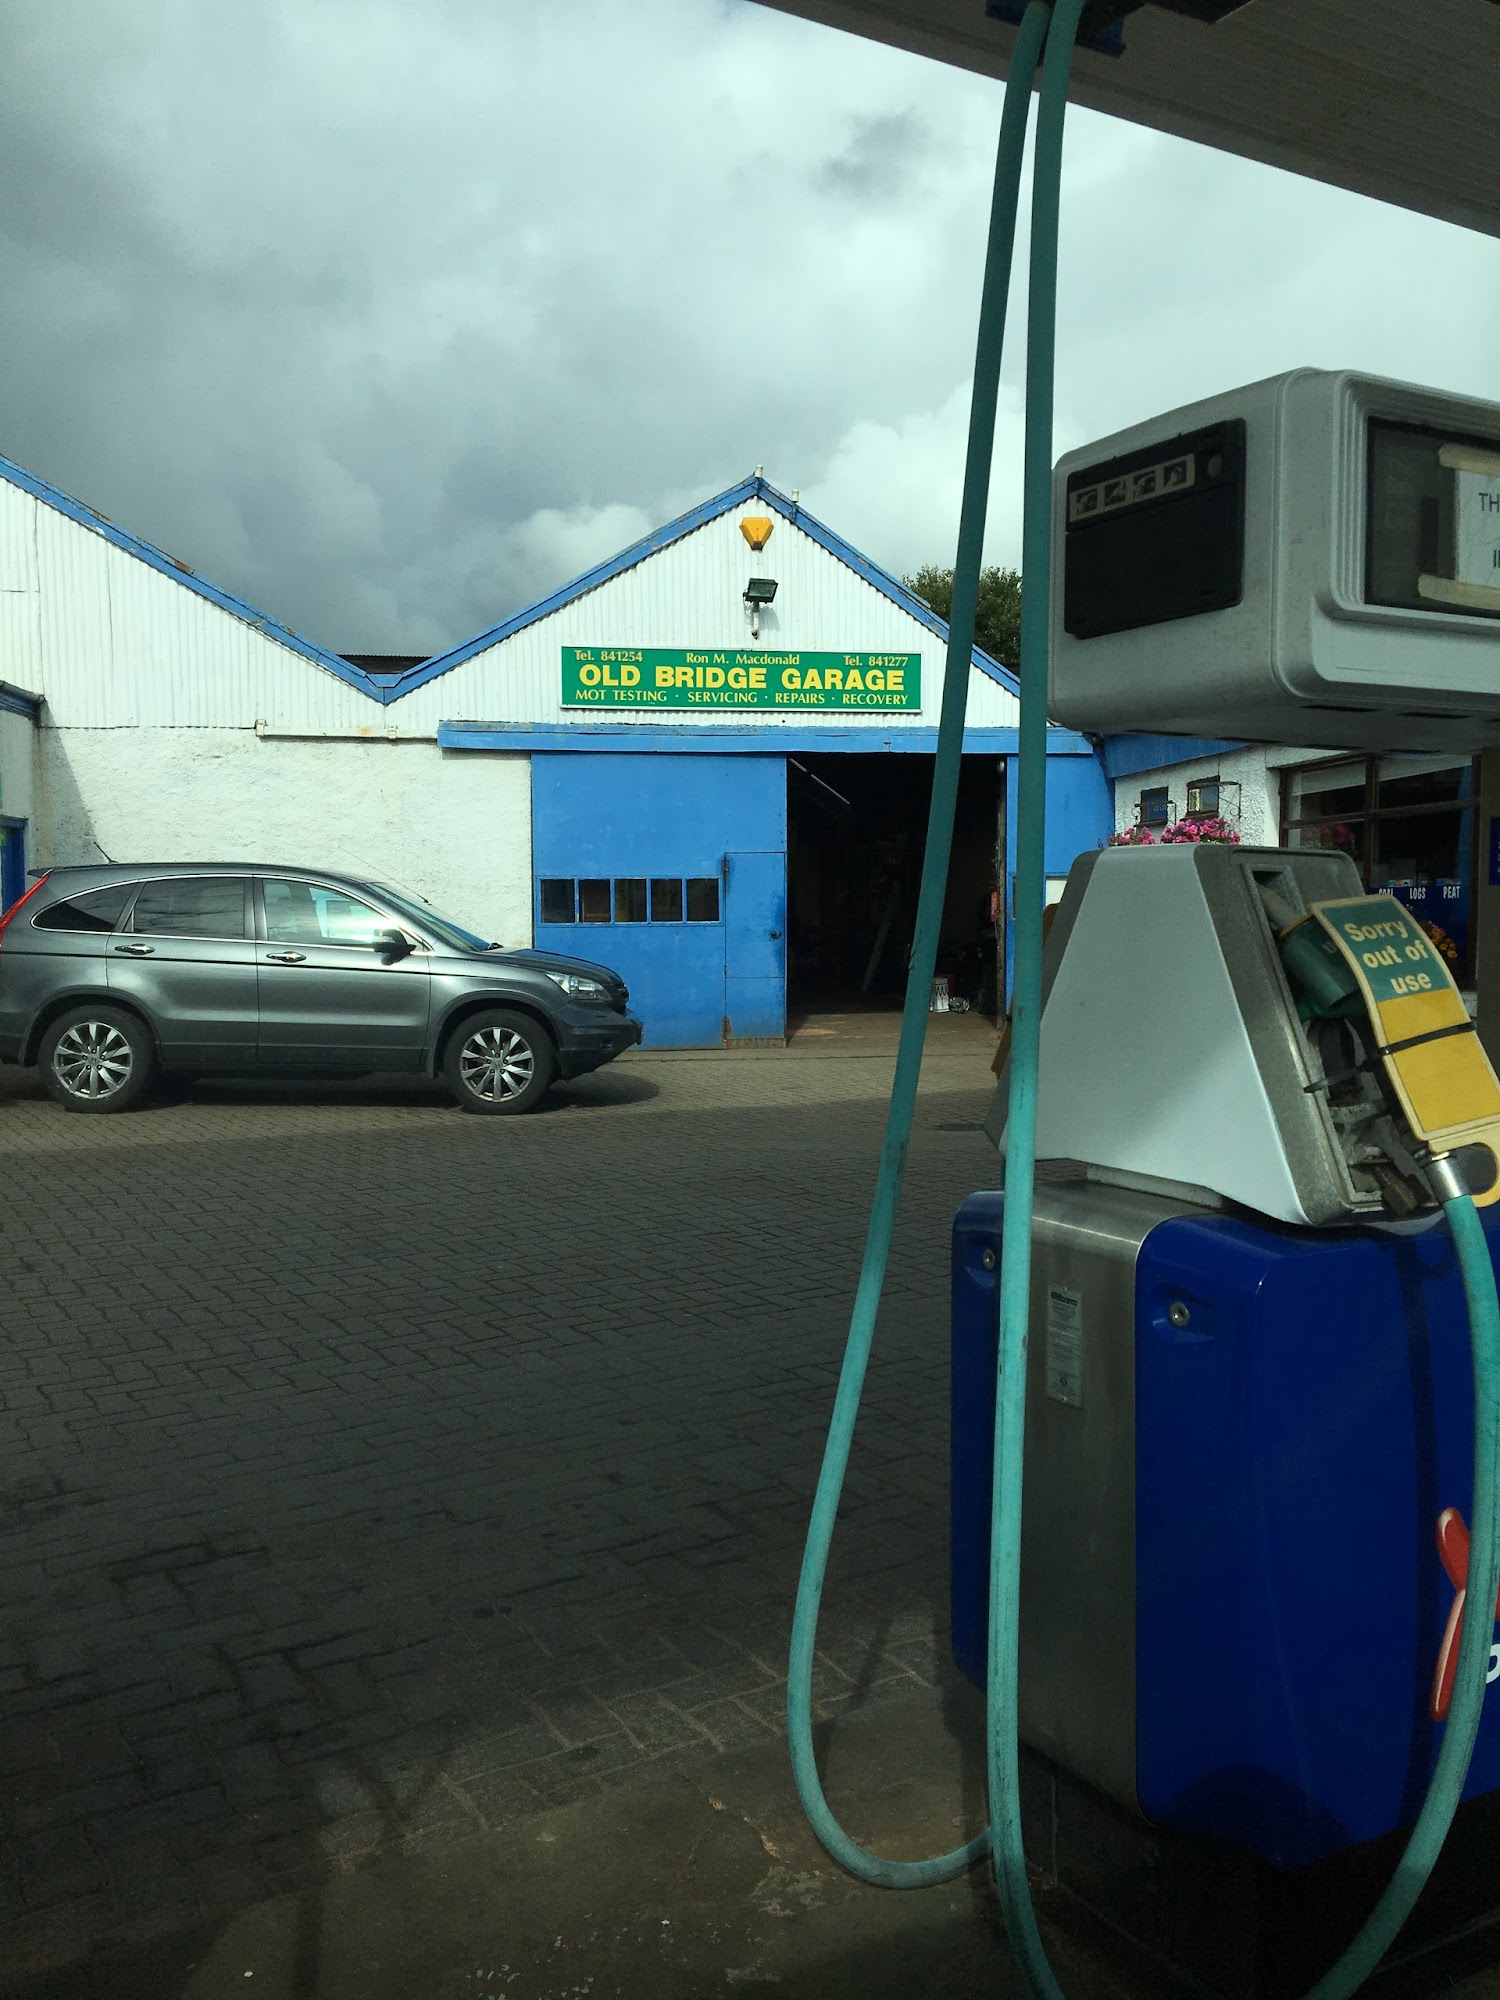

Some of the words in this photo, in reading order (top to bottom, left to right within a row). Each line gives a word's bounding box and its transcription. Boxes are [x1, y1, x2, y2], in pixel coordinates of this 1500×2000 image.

[574, 649, 595, 661] Tel.
[601, 650, 643, 662] 841254
[686, 652, 708, 664] Ron
[713, 653, 729, 664] M.
[736, 653, 800, 665] Macdonald
[843, 655, 863, 666] Tel.
[868, 656, 908, 667] 841277
[579, 664, 641, 687] OLD
[655, 665, 767, 689] BRIDGE
[781, 667, 904, 691] GARAGE
[575, 689, 607, 700] MOT
[612, 690, 667, 702] TESTING
[687, 691, 758, 703] SERVICING
[775, 692, 825, 704] REPAIRS
[842, 693, 908, 705] RECOVERY
[1409, 887, 1426, 900] LOGS
[1443, 886, 1461, 899] PEAT
[1343, 920, 1408, 942] Sorry
[1362, 945, 1403, 968] out
[1404, 939, 1429, 961] of
[1390, 972, 1432, 994] use
